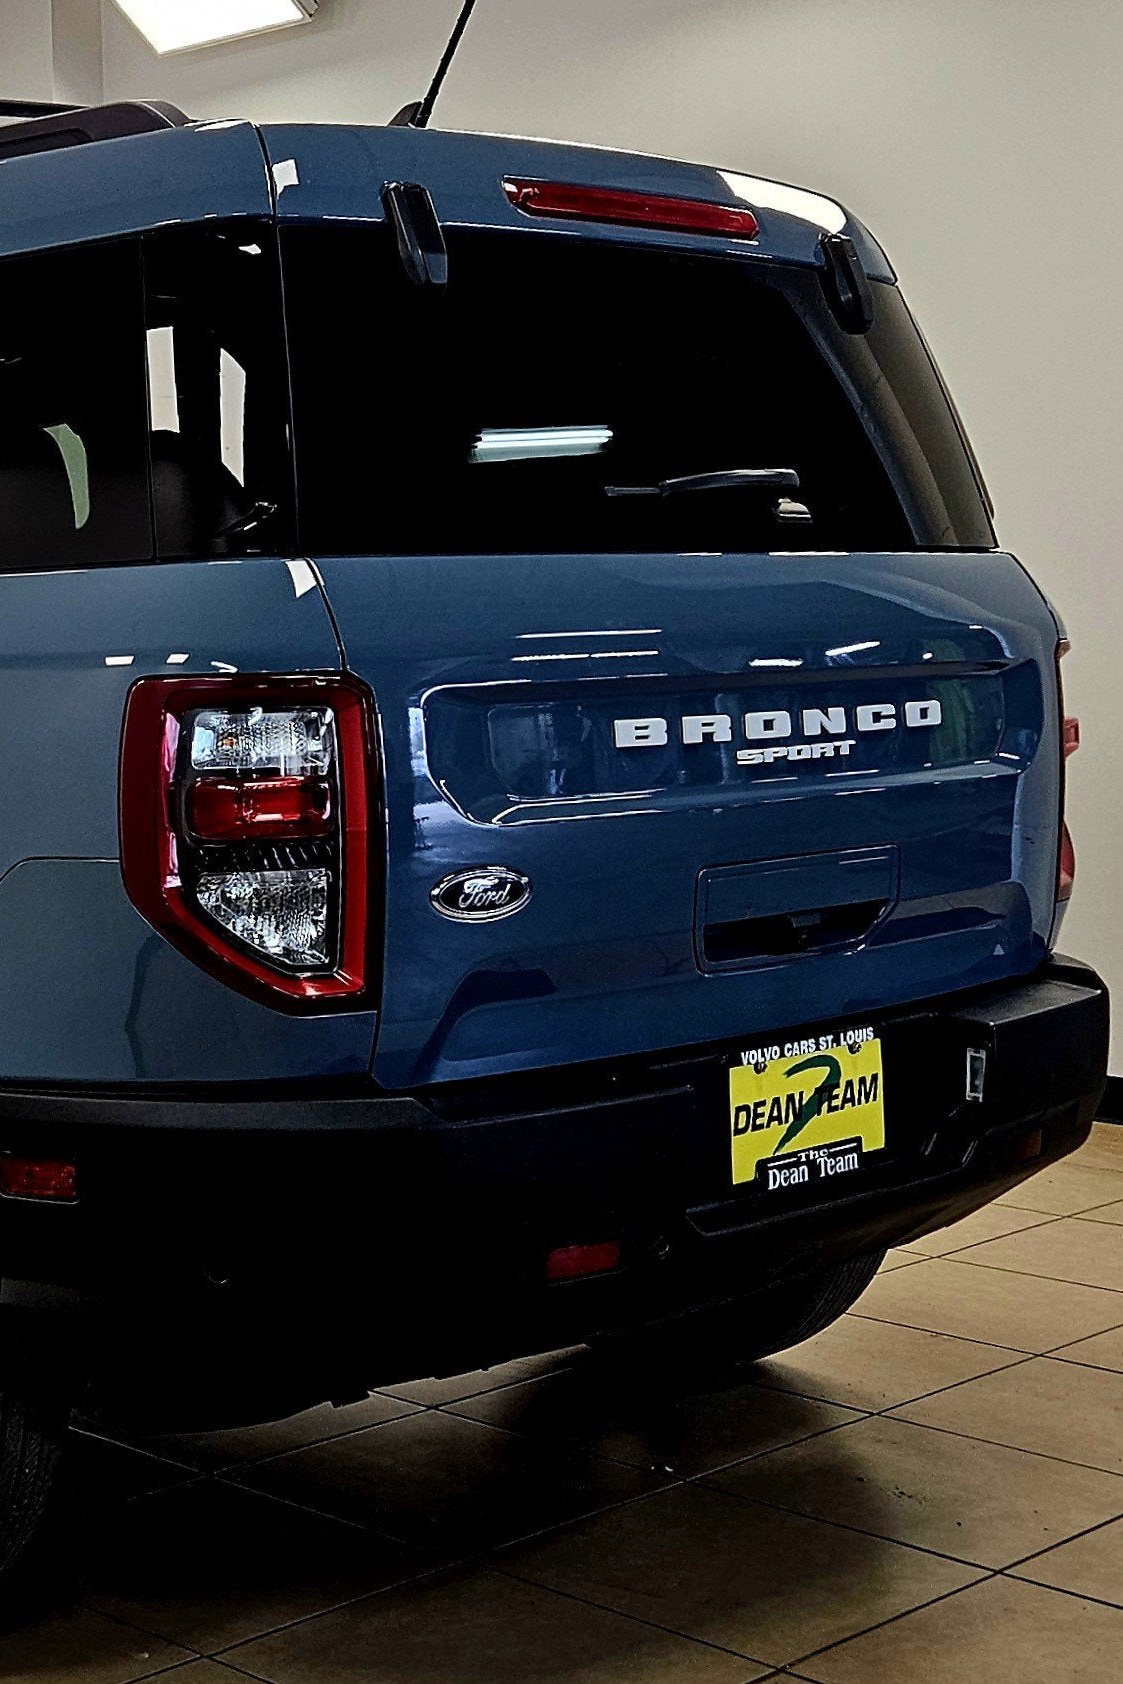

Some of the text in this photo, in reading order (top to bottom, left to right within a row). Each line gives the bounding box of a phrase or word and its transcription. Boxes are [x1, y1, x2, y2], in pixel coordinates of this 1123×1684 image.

[614, 700, 941, 748] BRONCO
[736, 740, 856, 765] SPORT
[459, 876, 511, 908] Ford
[741, 1027, 874, 1066] VOLVO CARS ST. LOUIS
[733, 1073, 879, 1137] DEAN TEAM
[768, 1152, 859, 1190] Dean Team
[797, 1149, 828, 1162] The
